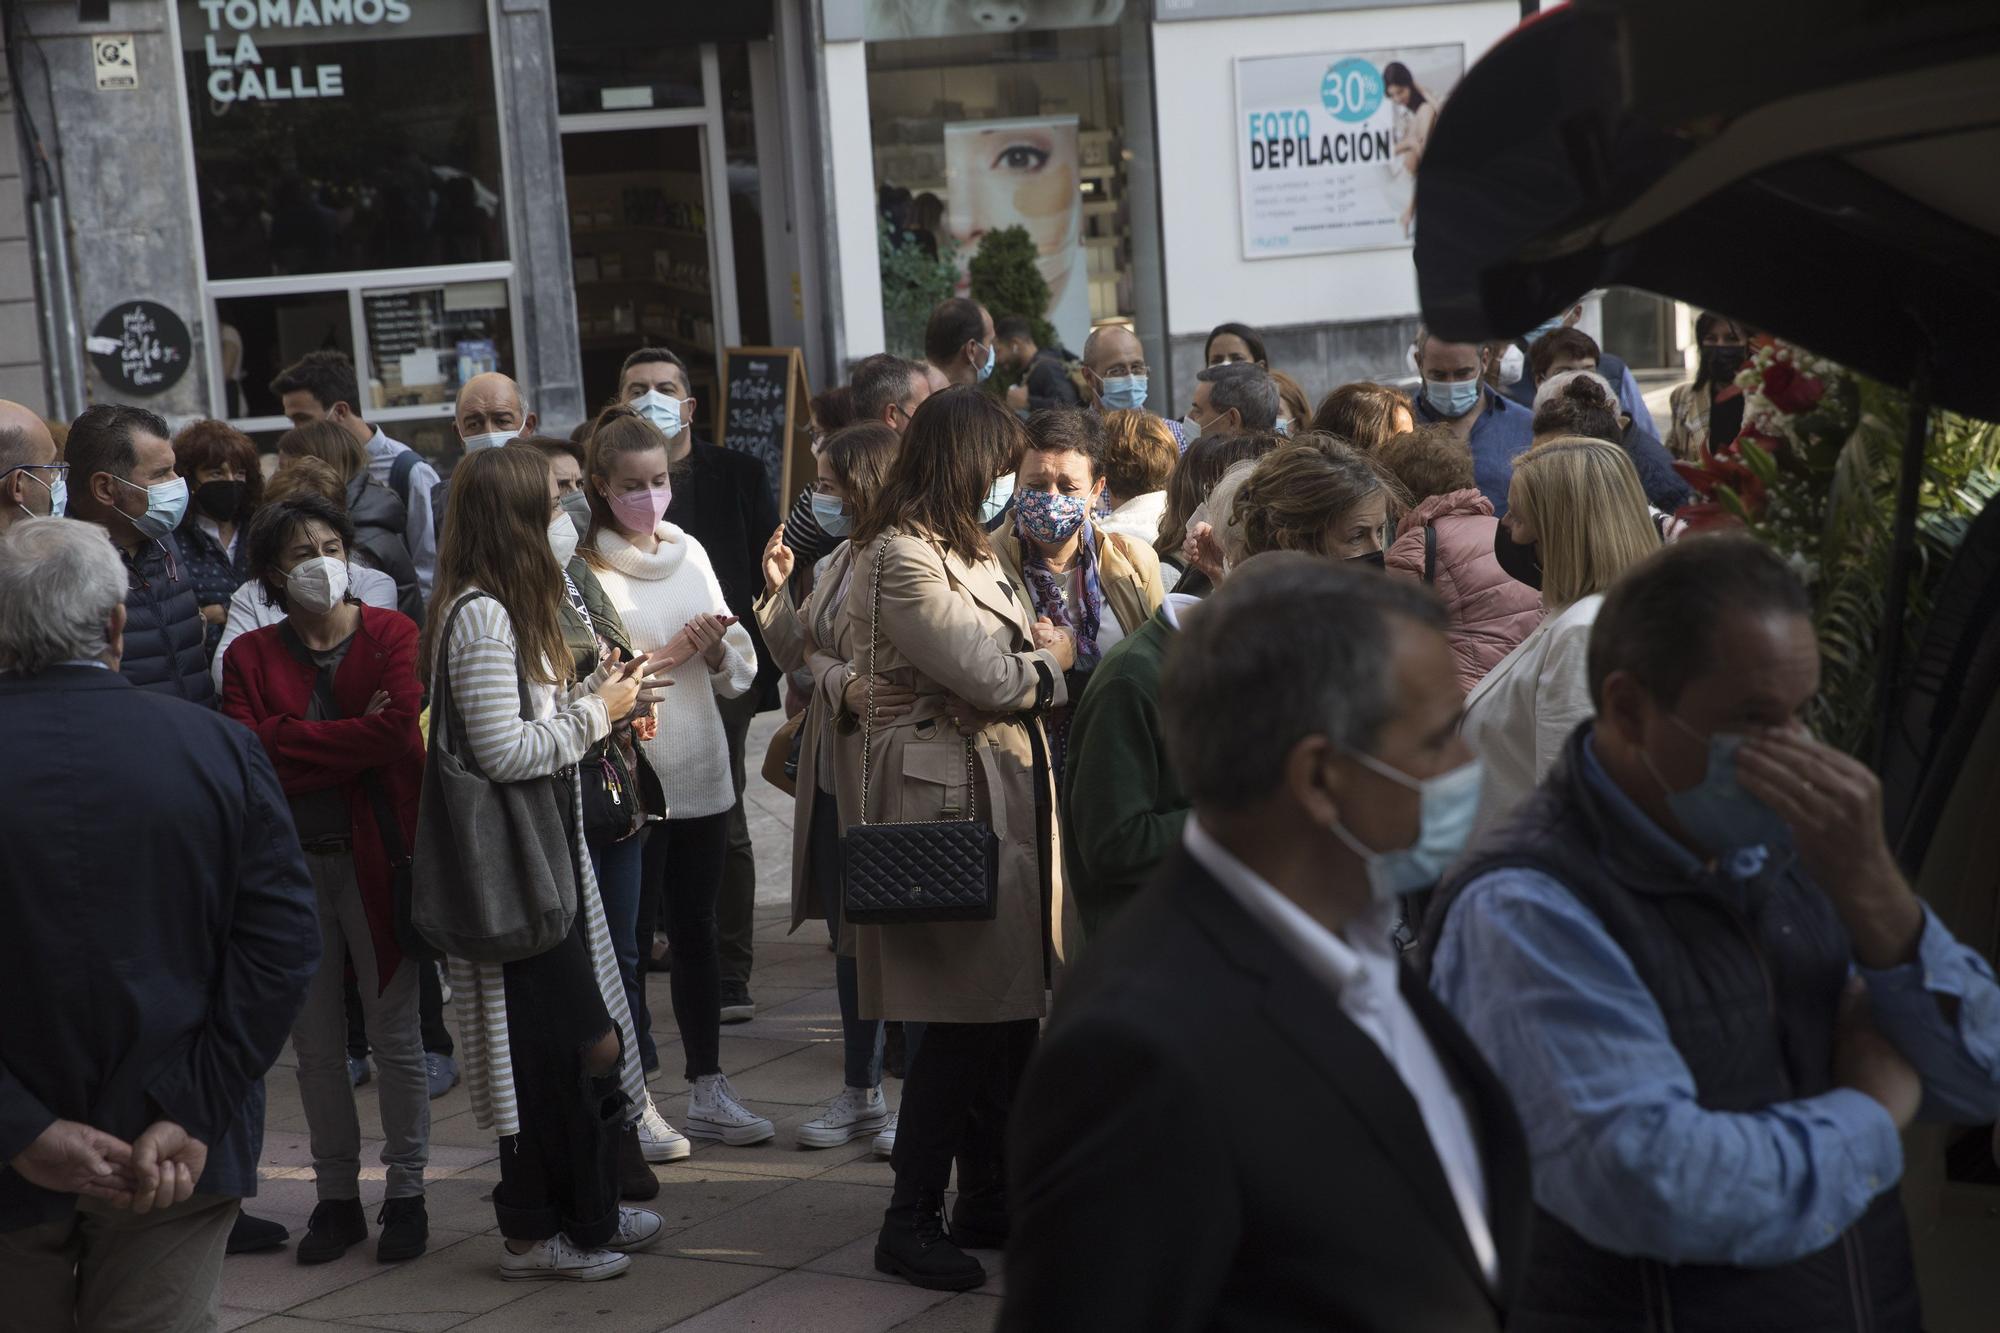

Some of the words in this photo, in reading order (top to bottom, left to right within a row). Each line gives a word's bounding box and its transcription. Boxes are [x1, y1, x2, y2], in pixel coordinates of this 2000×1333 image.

[200, 0, 411, 30] TOMAMOS
[204, 34, 262, 67] LA
[208, 64, 344, 101] CALLE
[1249, 109, 1310, 142] FOTO
[1251, 122, 1391, 170] DEPILACIÓN
